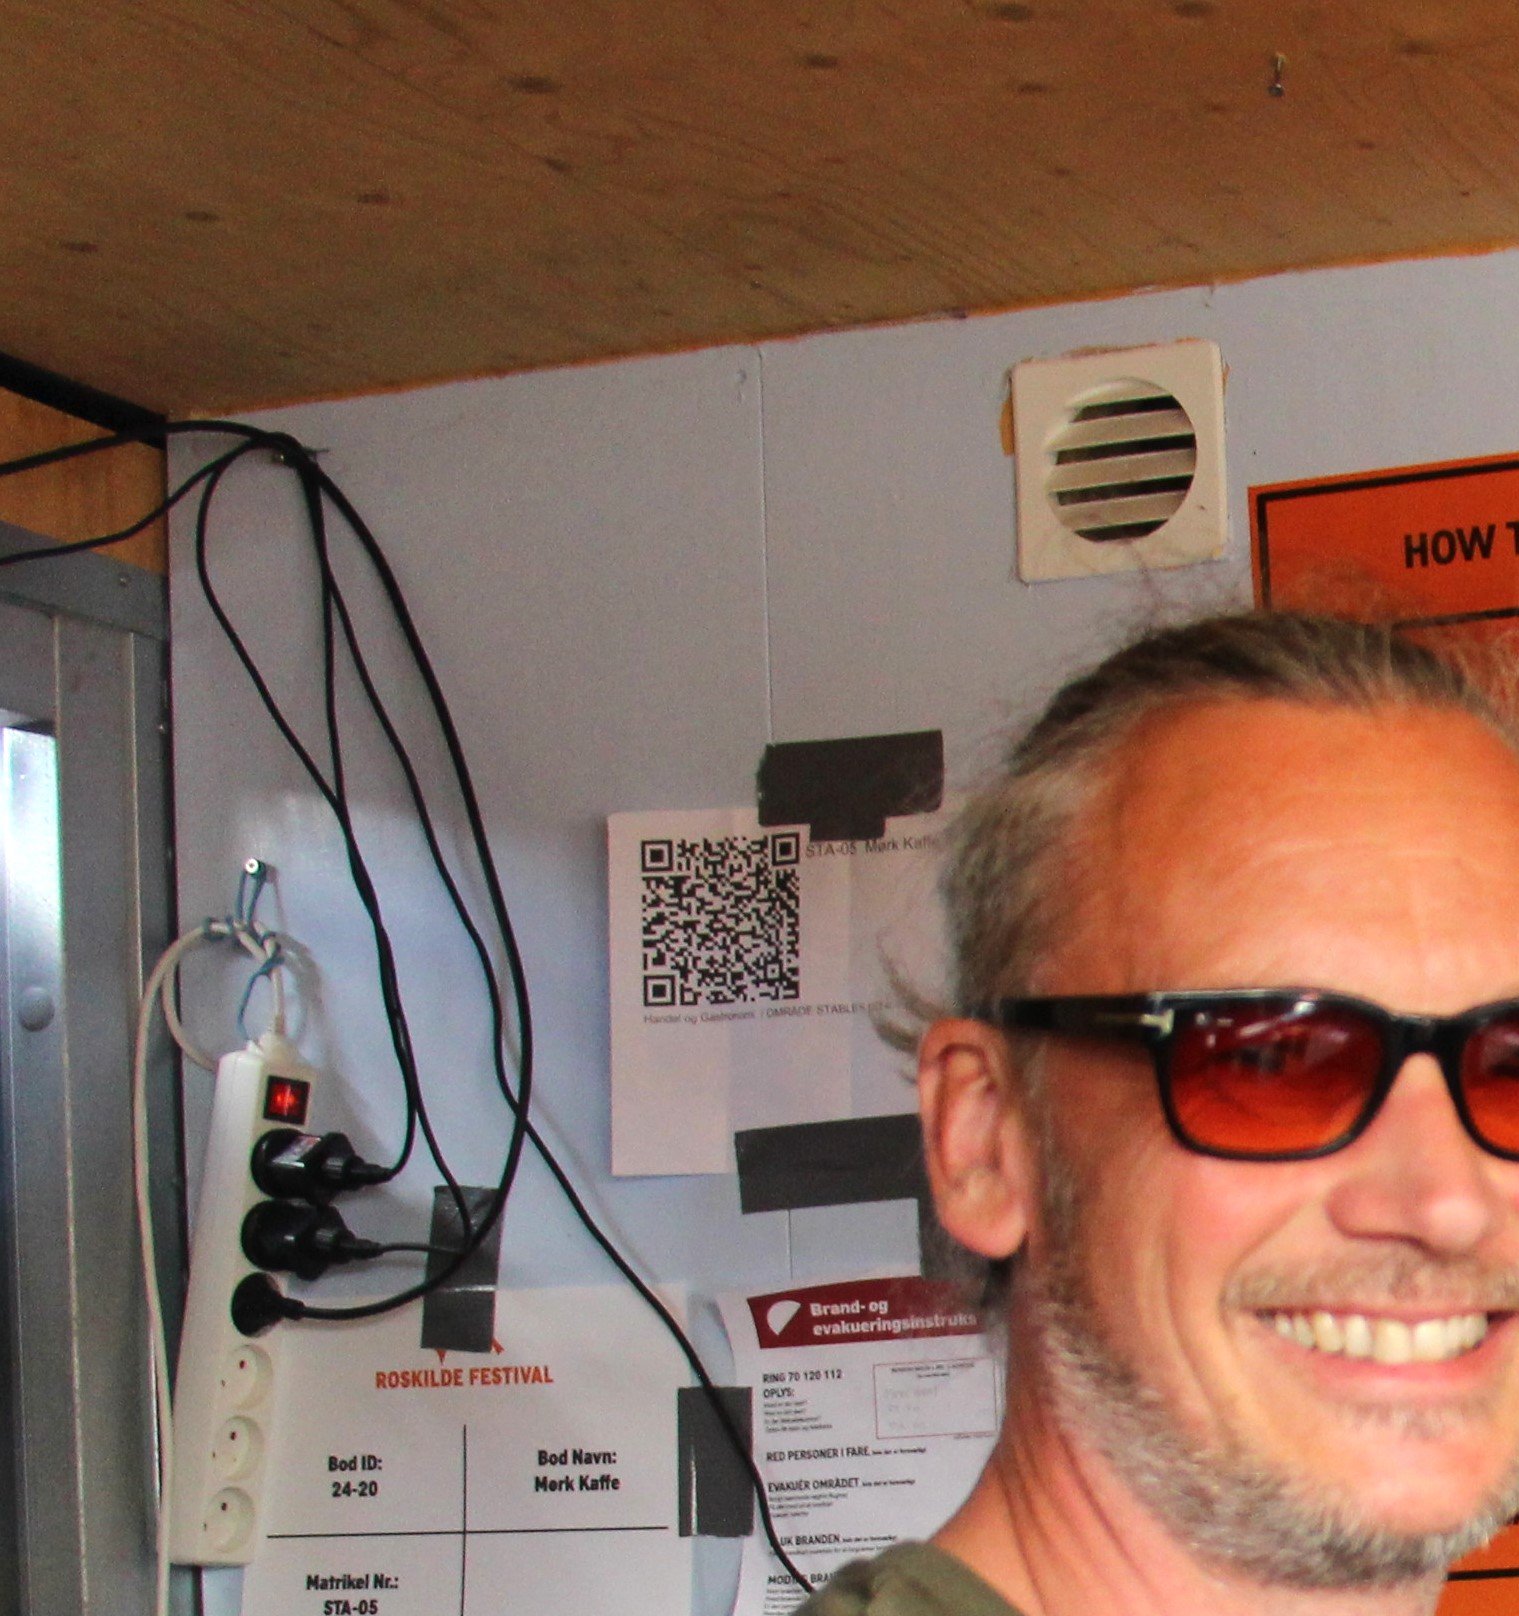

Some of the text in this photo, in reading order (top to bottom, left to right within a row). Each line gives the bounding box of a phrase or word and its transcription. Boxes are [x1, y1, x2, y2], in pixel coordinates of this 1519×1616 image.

[1403, 522, 1495, 569] HOW
[805, 842, 857, 858] STA-05
[810, 1300, 889, 1317] Brand- og
[375, 1365, 554, 1390] ROSKILDE FESTIVAL
[762, 1371, 786, 1384] RING
[824, 1368, 843, 1380] 112
[537, 1449, 618, 1467] Bod Navn:
[766, 1451, 785, 1462] RED
[787, 1449, 839, 1461] PERSONER
[846, 1446, 871, 1458] FARE
[328, 1455, 383, 1472] Bod ID:
[331, 1481, 379, 1498] 24-20
[578, 1474, 621, 1492] Kaffe
[794, 1534, 841, 1547] BRANDEN
[305, 1574, 399, 1592] Matrikel Nr.:
[323, 1600, 379, 1616] STA-05
